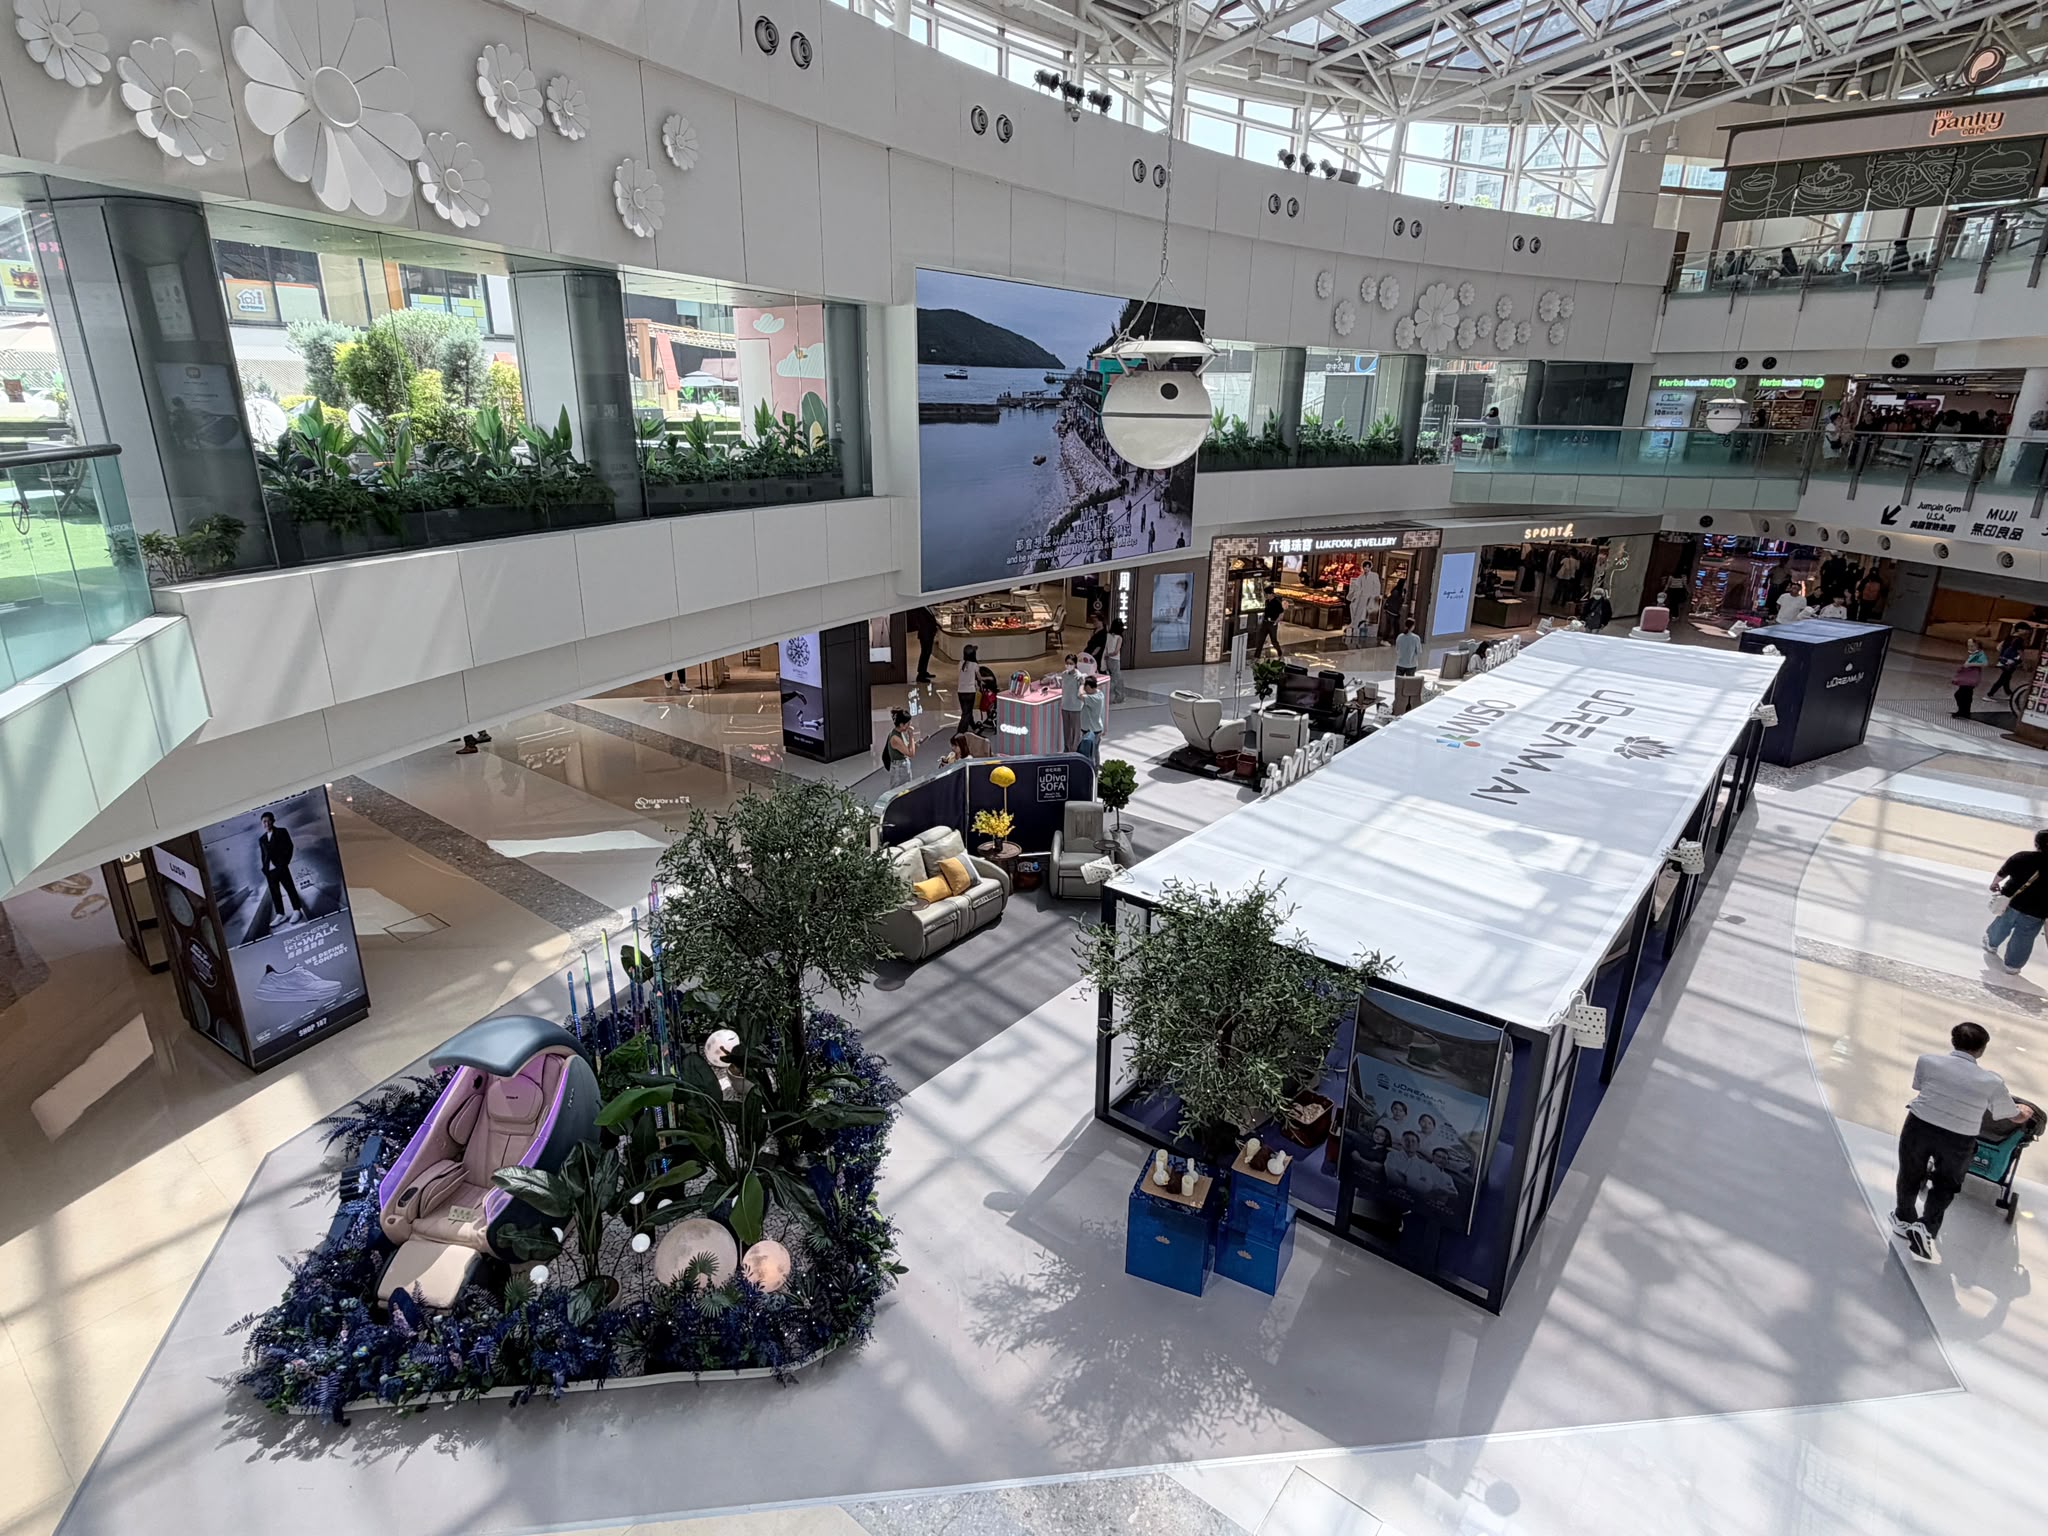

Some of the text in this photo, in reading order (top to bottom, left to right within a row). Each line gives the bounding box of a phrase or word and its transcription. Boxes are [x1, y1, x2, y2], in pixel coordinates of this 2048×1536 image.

[1931, 111, 2005, 137] pantry
[1658, 378, 1684, 387] Herbs
[1917, 502, 1961, 514] Jumpin Gym
[1986, 508, 2018, 522] MUJI
[1524, 527, 1562, 539] SPORT
[1970, 522, 2024, 541] 無印良品
[1268, 536, 1397, 553] 六福珠寶 LUKFOOK JEWELLERY
[1006, 555, 1018, 565] and
[1019, 554, 1027, 563] be
[1437, 699, 1517, 735] OSIM
[1039, 773, 1067, 783] uDiva
[1040, 782, 1065, 792] SOFA
[169, 863, 187, 879] LUSH
[304, 955, 317, 965] WE
[318, 943, 344, 959] DEFINE
[313, 946, 348, 966] COMFORT
[298, 1024, 317, 1037] SHOP
